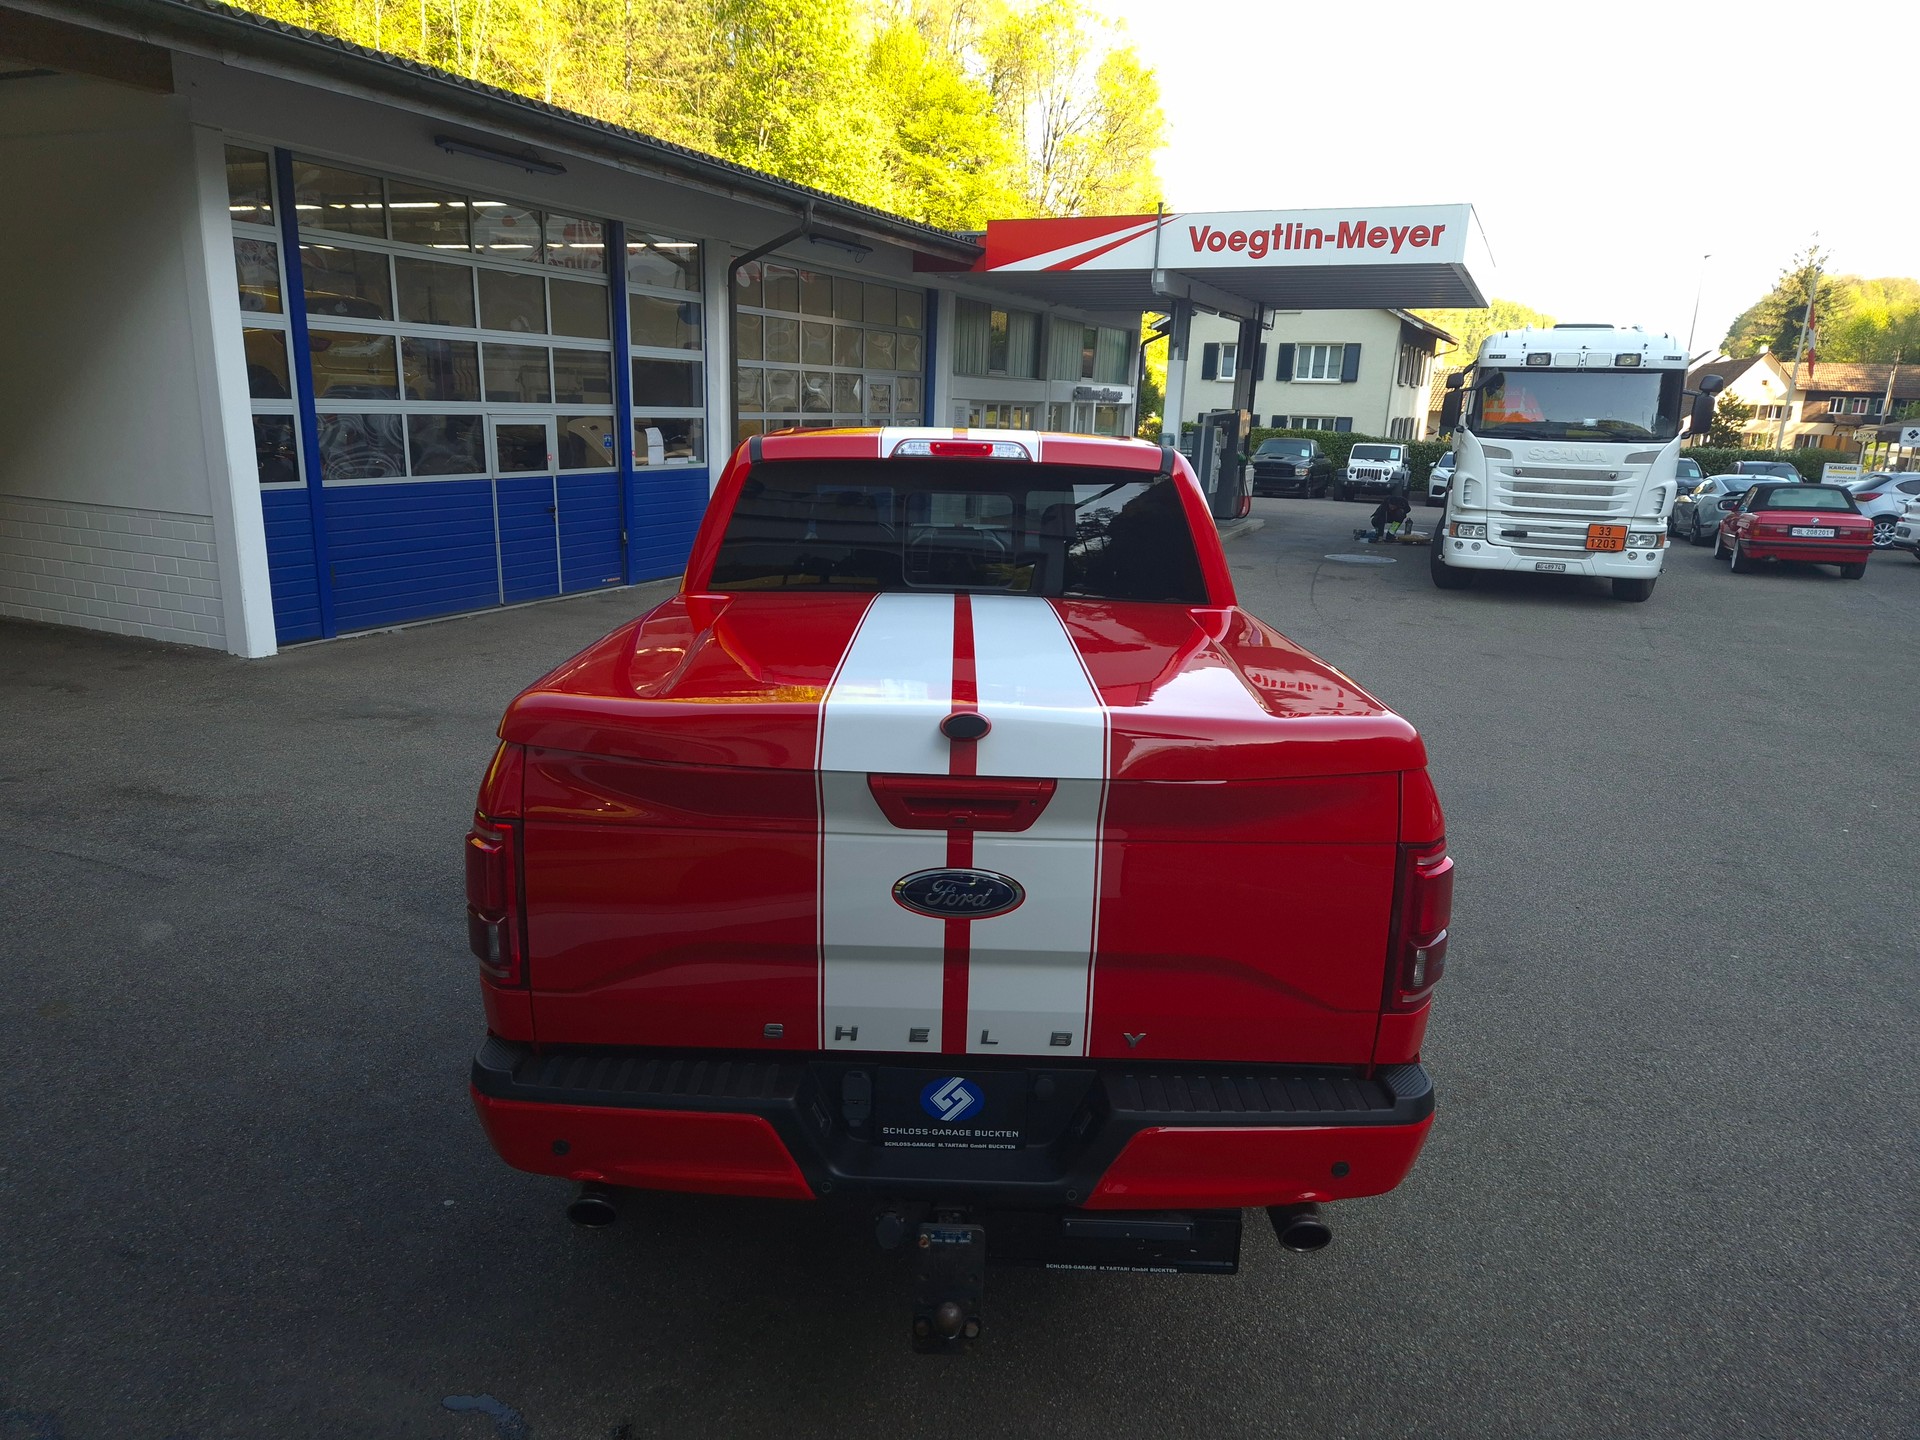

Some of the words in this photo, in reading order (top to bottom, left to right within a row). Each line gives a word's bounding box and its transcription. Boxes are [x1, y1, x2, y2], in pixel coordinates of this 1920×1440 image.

[1188, 220, 1446, 260] Voegtlin-Meyer
[1527, 446, 1608, 463] SCANIA
[1598, 526, 1612, 537] 33
[1590, 538, 1617, 549] 1203
[925, 878, 993, 908] Ford
[763, 1023, 1147, 1050] SHELBY
[974, 1129, 1019, 1138] BUCKTEN
